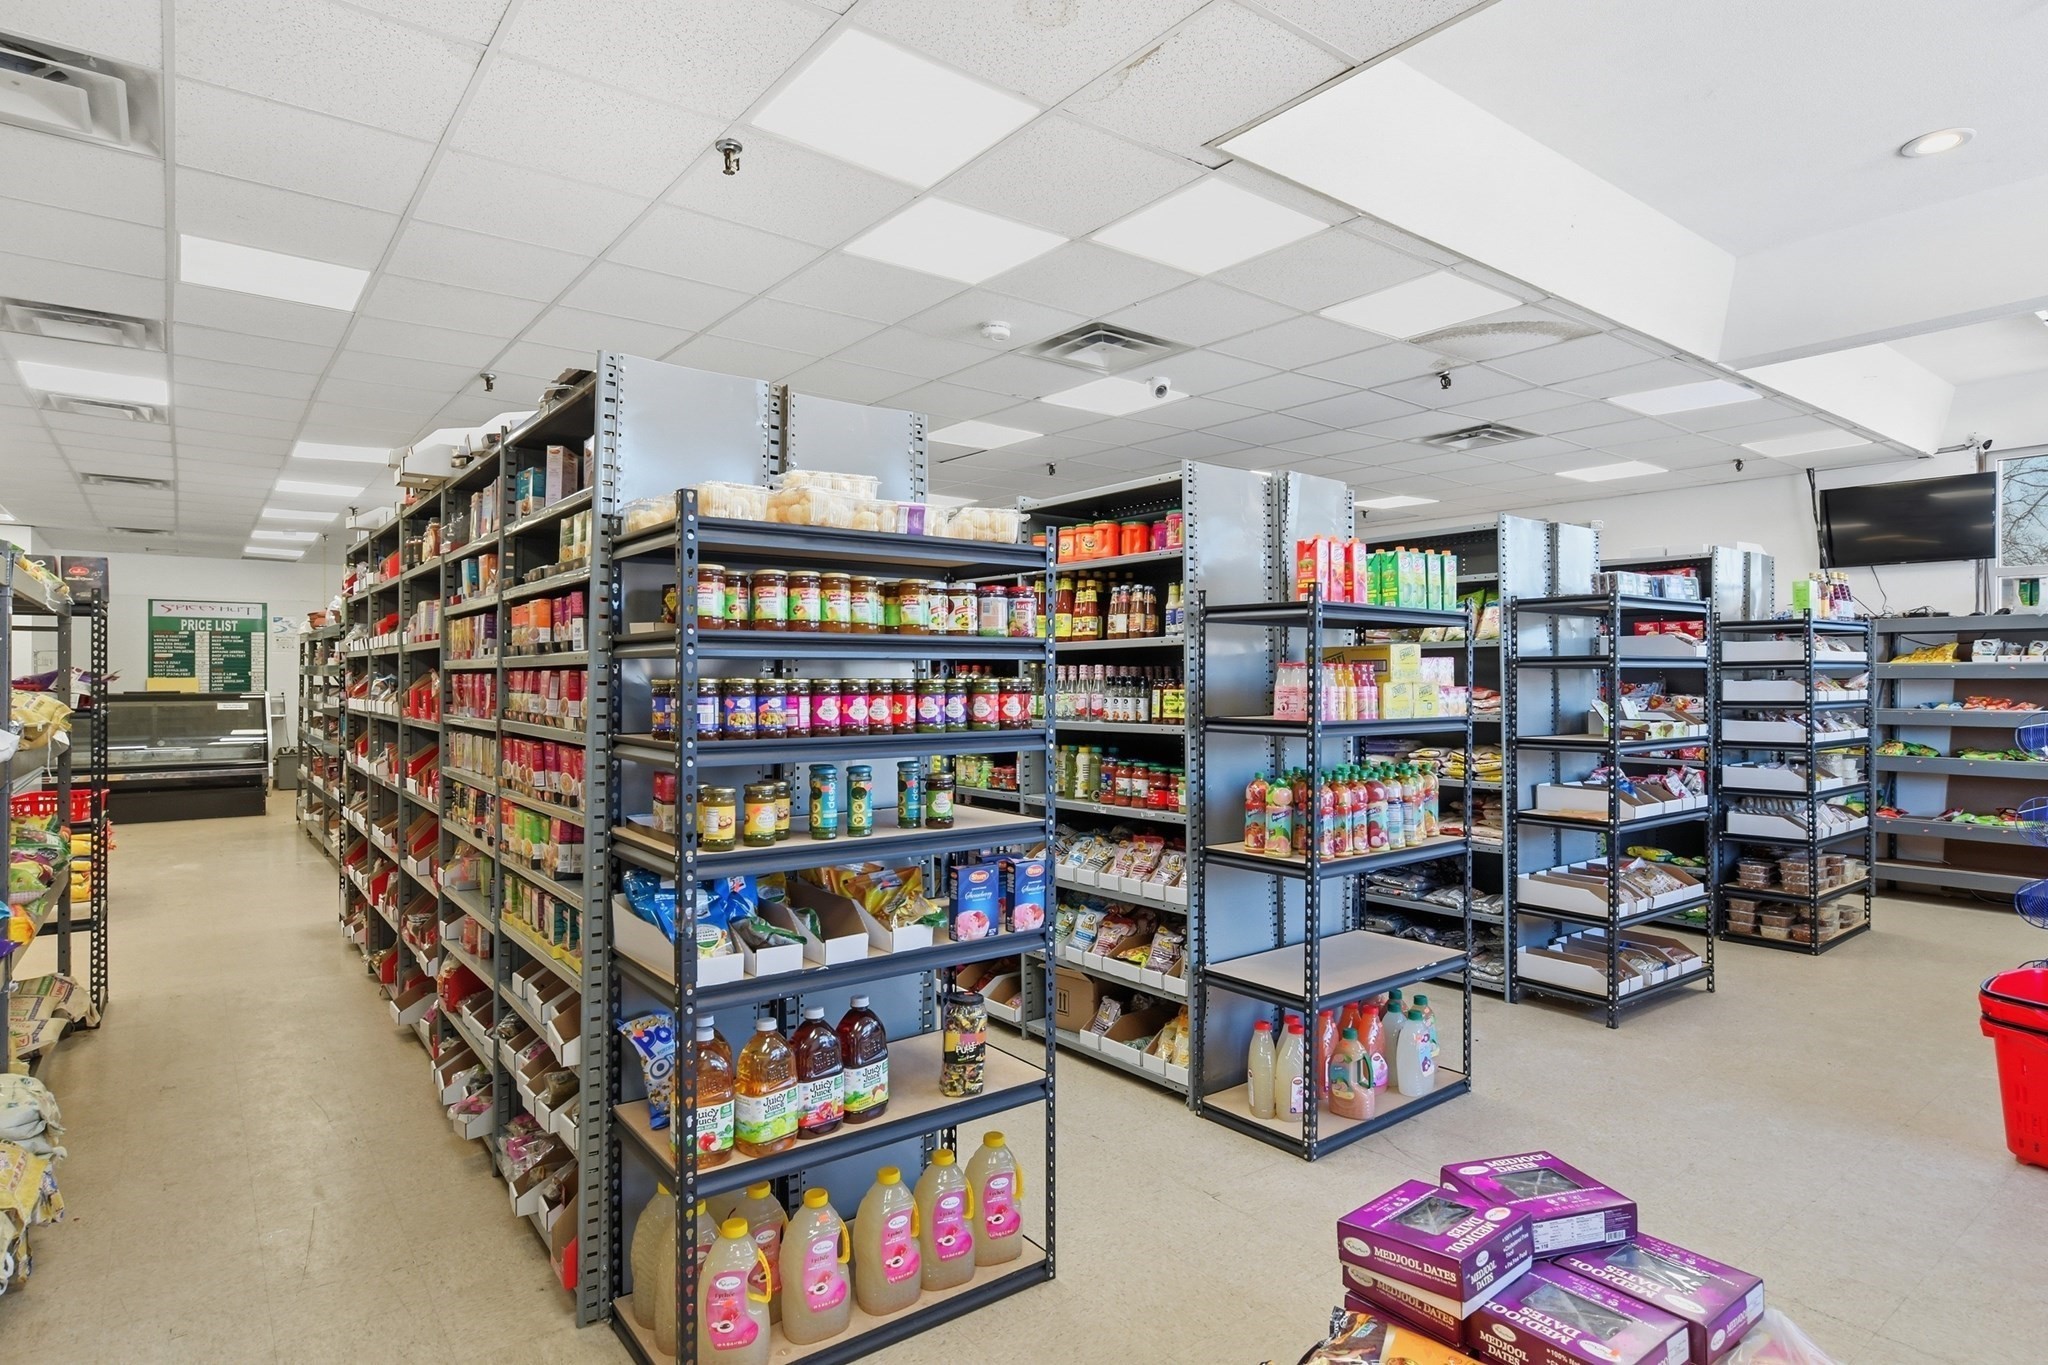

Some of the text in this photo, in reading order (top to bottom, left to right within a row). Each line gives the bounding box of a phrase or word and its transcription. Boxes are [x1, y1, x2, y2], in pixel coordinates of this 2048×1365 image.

[181, 619, 239, 632] PRICE LIST
[862, 1063, 882, 1077] Juicy
[863, 1073, 881, 1083] Juice
[809, 1079, 834, 1093] Juicy
[811, 1087, 832, 1099] Juice
[762, 1093, 786, 1107] Juicy
[764, 1101, 785, 1113] Juice
[1484, 1153, 1552, 1168] MEDJOOL
[1444, 1220, 1500, 1254] MEDJOOL
[1446, 1215, 1485, 1239] DATES
[1373, 1246, 1422, 1271] MEDJOOL
[1423, 1262, 1457, 1283] DATES
[1470, 1260, 1497, 1285] MEDJOOL
[1476, 1272, 1494, 1291] DATES
[1569, 1258, 1659, 1299] MEDJOOL
[1603, 1265, 1666, 1293] DATES
[1376, 1280, 1422, 1310] MEDJOOL
[1423, 1304, 1455, 1326] DATES
[1485, 1299, 1574, 1346] MEDJOOL
[1518, 1306, 1582, 1339] DATES
[1479, 1330, 1530, 1363] MEDJOOL
[1487, 1343, 1521, 1365] DATES
[1550, 1349, 1568, 1364] 100%
